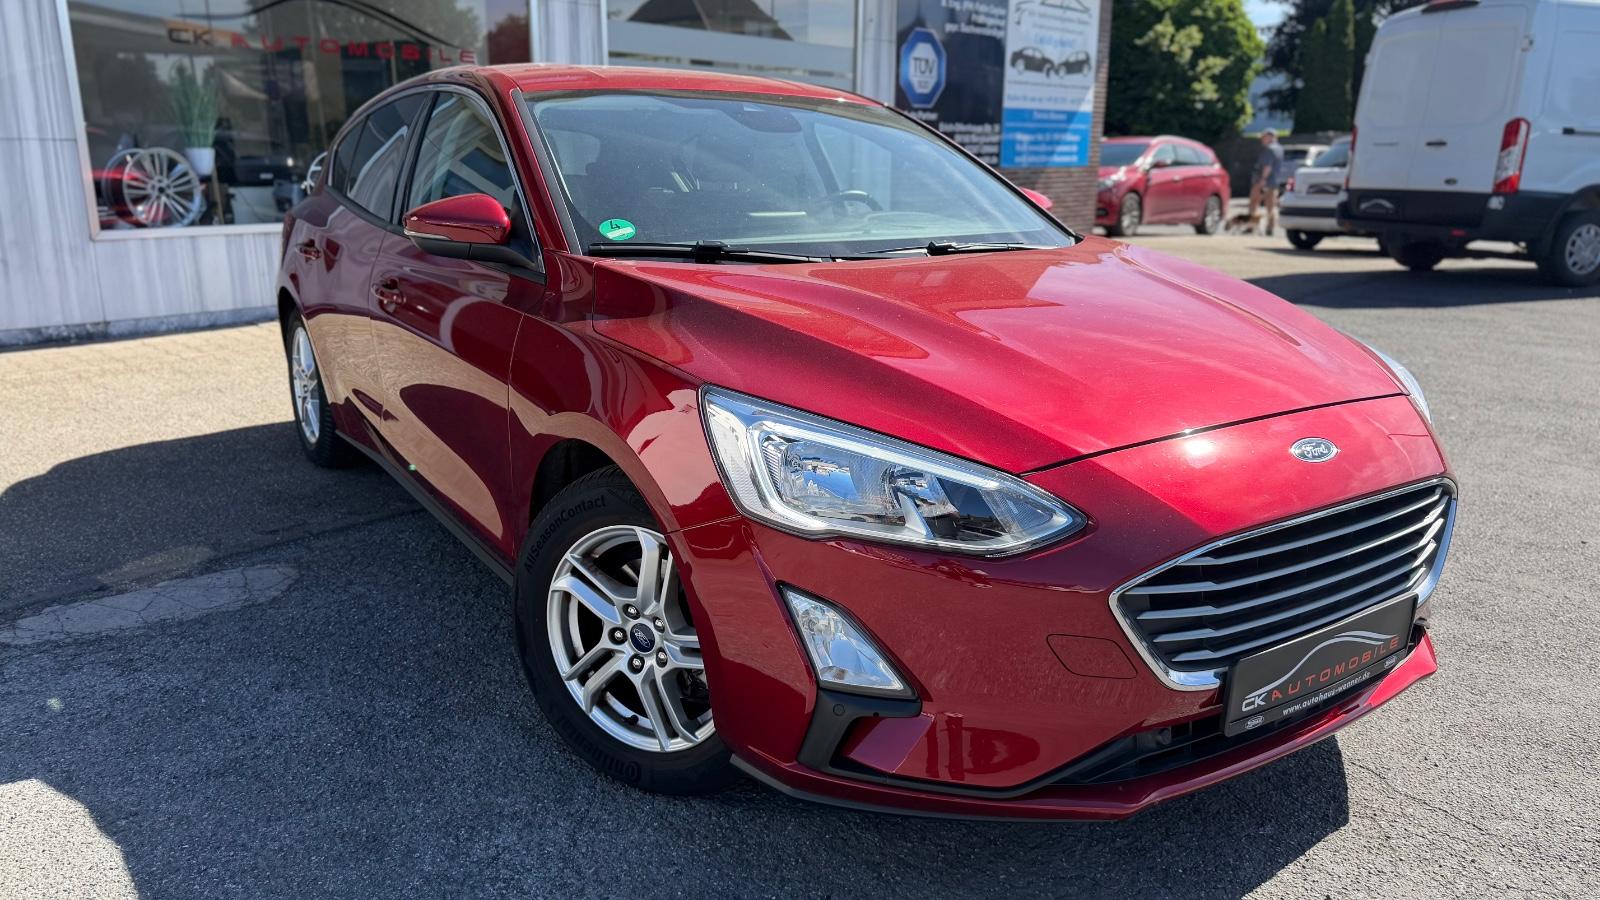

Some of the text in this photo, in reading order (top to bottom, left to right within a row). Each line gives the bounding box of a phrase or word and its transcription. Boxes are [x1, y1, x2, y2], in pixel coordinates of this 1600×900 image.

[167, 27, 476, 64] CK AUTOMOBILE
[609, 219, 621, 230] 4
[1294, 440, 1333, 460] Ford
[523, 495, 607, 574] AllSeasonContact
[1241, 636, 1400, 711] CK AUTOMOBILE
[1281, 670, 1371, 716] www.autohaus-wenner.de
